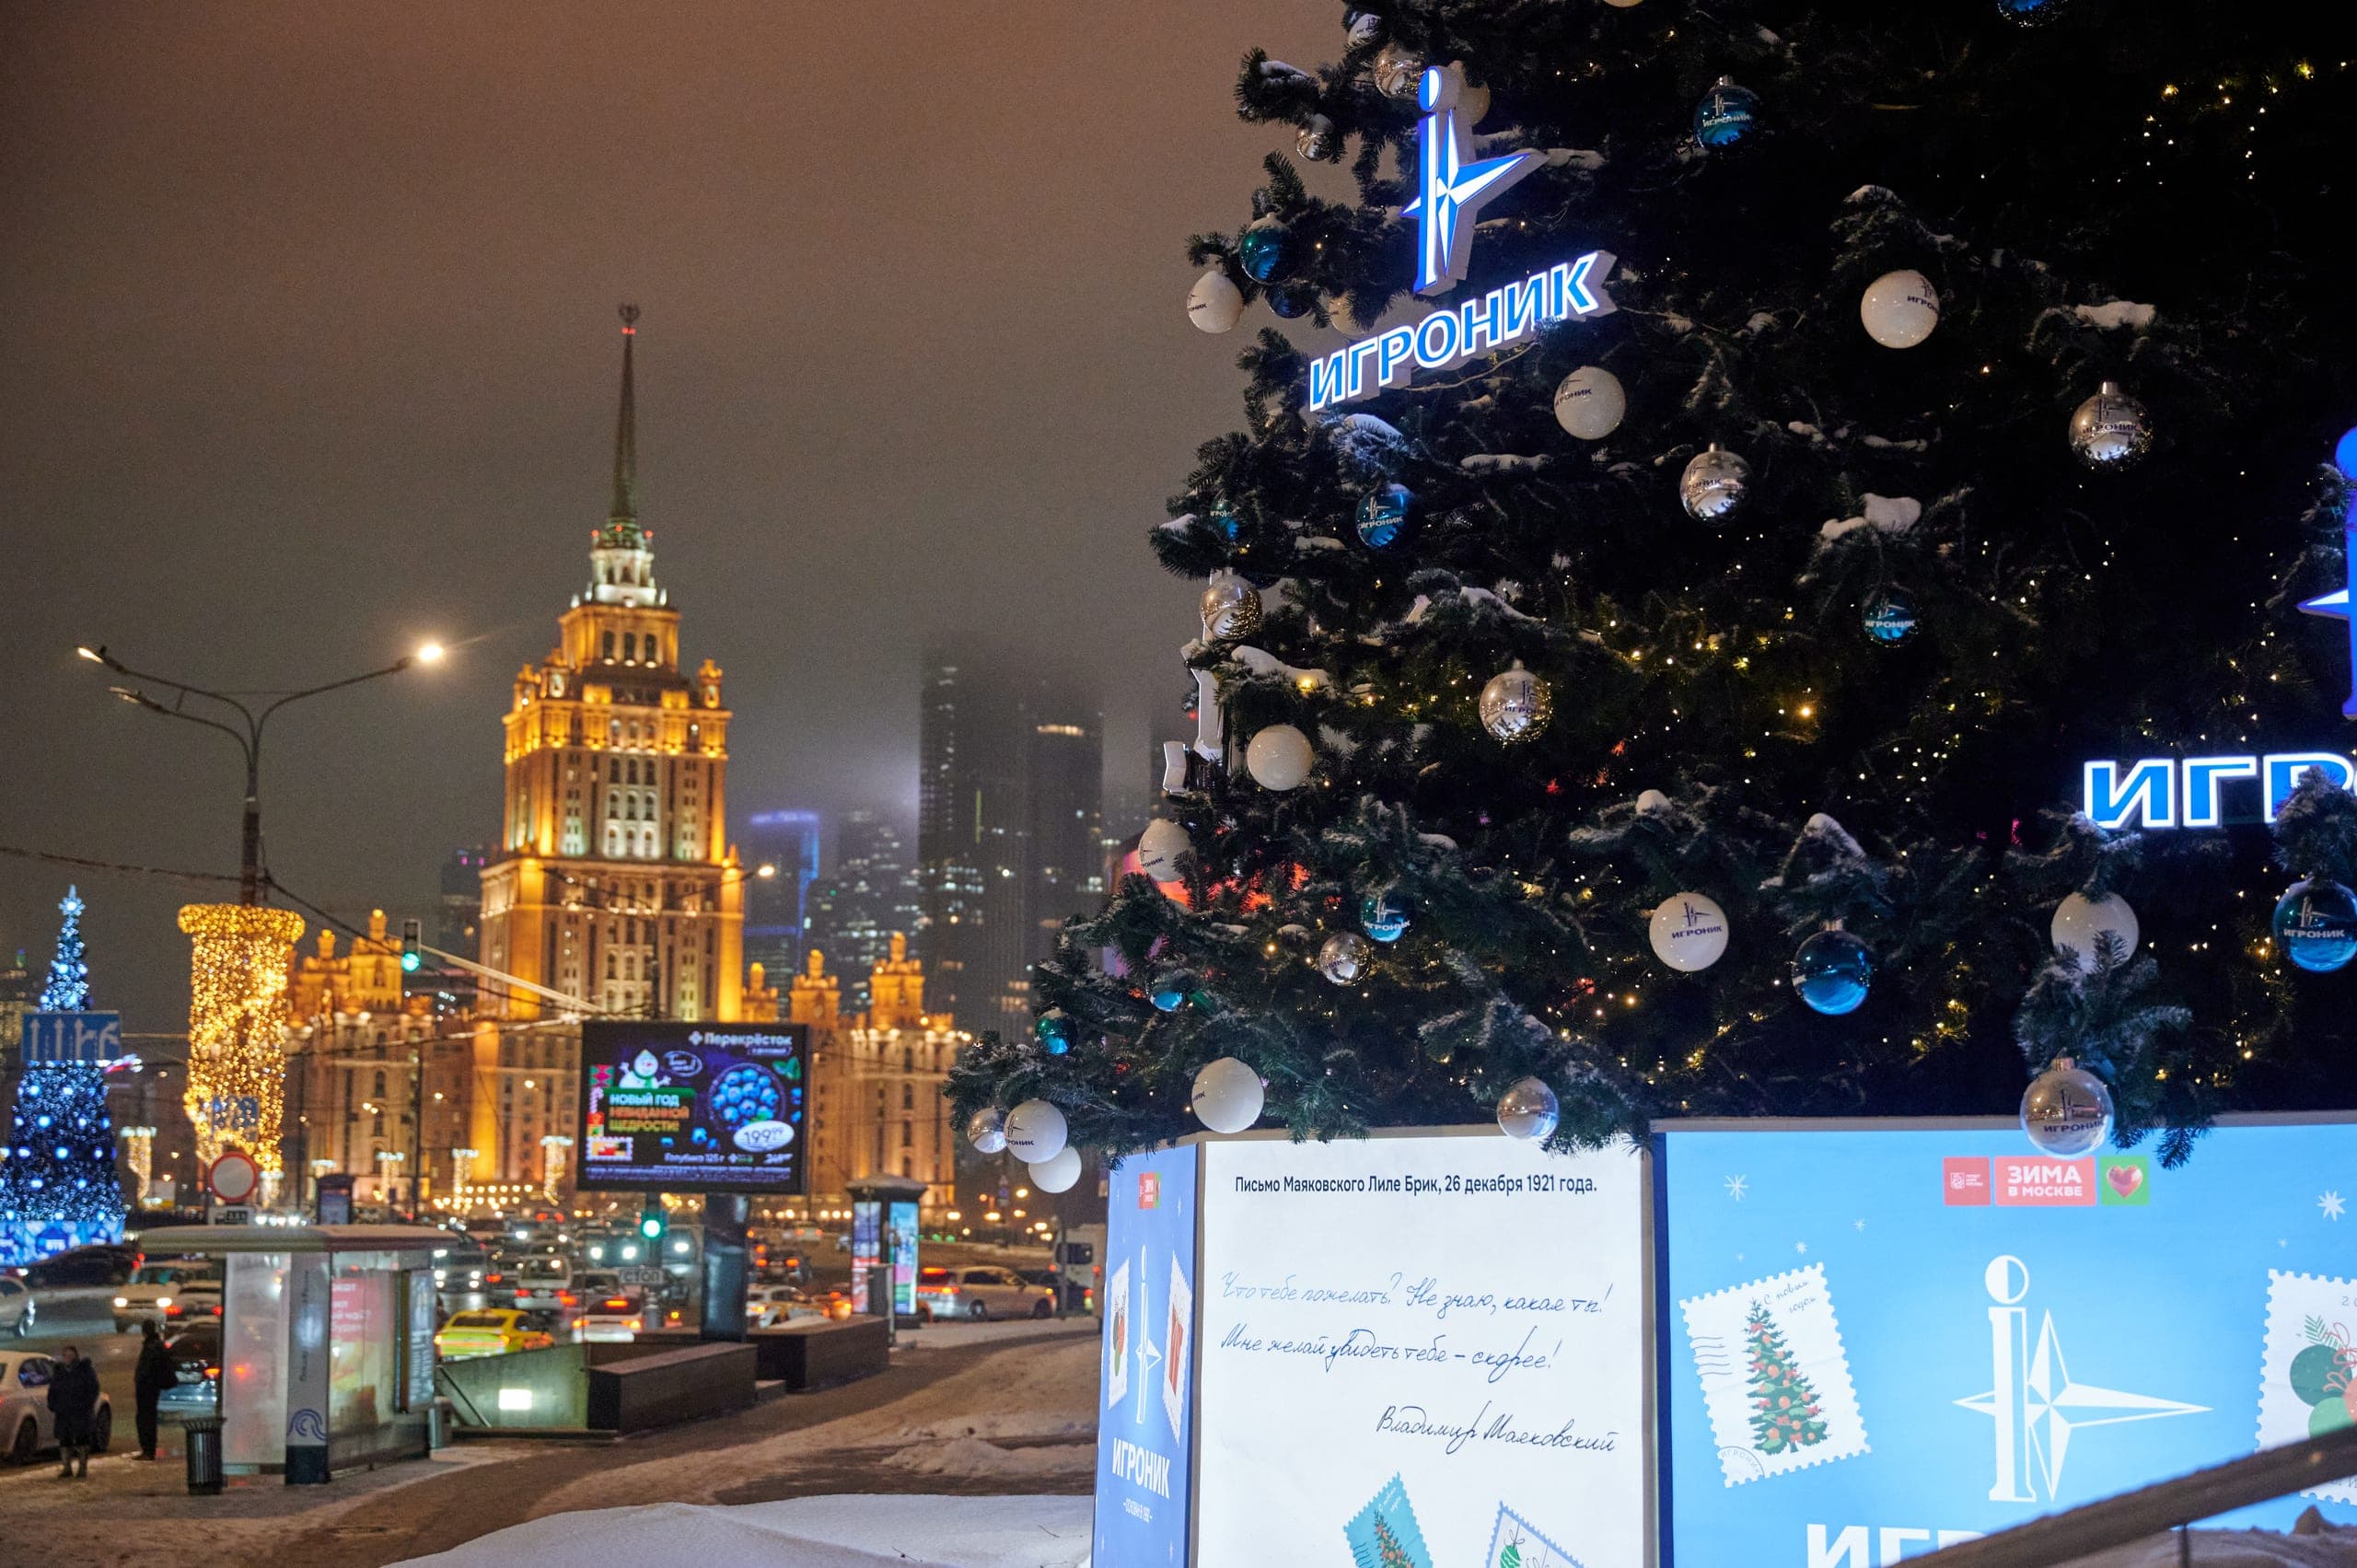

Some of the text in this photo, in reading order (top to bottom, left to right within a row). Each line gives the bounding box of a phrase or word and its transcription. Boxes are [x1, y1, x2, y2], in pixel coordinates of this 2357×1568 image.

[1703, 111, 1751, 127] ИГРОНИК
[1308, 250, 1601, 412] ИГРОНИК
[2083, 750, 2357, 830] ИГР
[1671, 925, 1723, 939] ИГРОНИК
[2283, 928, 2345, 940] ИГРОНИК
[609, 1092, 680, 1108] НОВЫЙ ГОД
[2044, 1119, 2104, 1132] ИГРОНИК
[2007, 1165, 2083, 1184] ЗИМА
[1235, 1174, 1597, 1196] Письмо Маяковского Лиле Брик, 26 декабря 1921 года.
[2008, 1185, 2084, 1197] В МОСКВЕ
[1221, 1272, 1256, 1298] Что
[1260, 1274, 1297, 1301] тебе
[1300, 1272, 1403, 1305] пожелать?
[1407, 1277, 1437, 1307] Не
[1436, 1293, 1497, 1319] знаю,
[1504, 1297, 1565, 1312] какая
[1221, 1323, 1262, 1350] Мне
[1267, 1335, 1329, 1355] желай
[1324, 1329, 1399, 1373] увидеть
[1405, 1334, 1448, 1362] тебя
[1471, 1326, 1562, 1384] скорее!
[1376, 1400, 1620, 1455] Владимир Маяковский
[1111, 1436, 1170, 1500] ИГРОНИК
